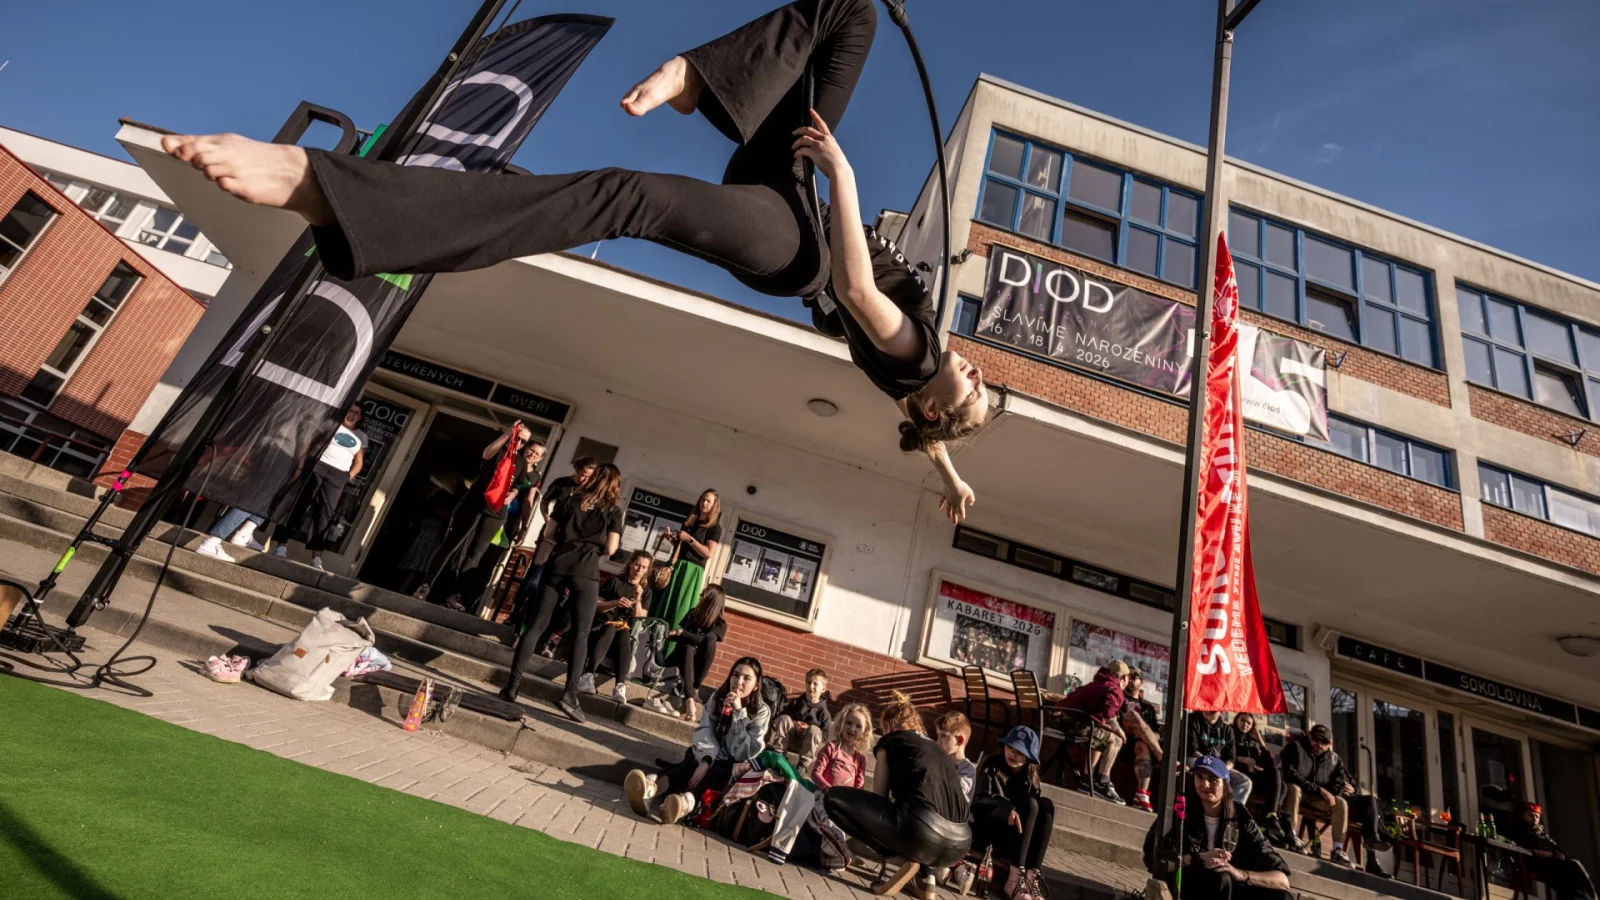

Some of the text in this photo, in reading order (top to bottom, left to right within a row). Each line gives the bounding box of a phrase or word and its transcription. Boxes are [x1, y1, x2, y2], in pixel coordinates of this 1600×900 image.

[998, 252, 1114, 313] DIOD
[991, 304, 1185, 375] SLAVÍME NAROZENINY
[1076, 348, 1110, 369] 2026
[384, 354, 550, 414] TEVŘENÝCH DVEŘÍ
[946, 599, 1041, 635] KABARET 2026
[1460, 675, 1543, 711] SOKOLOVNA
